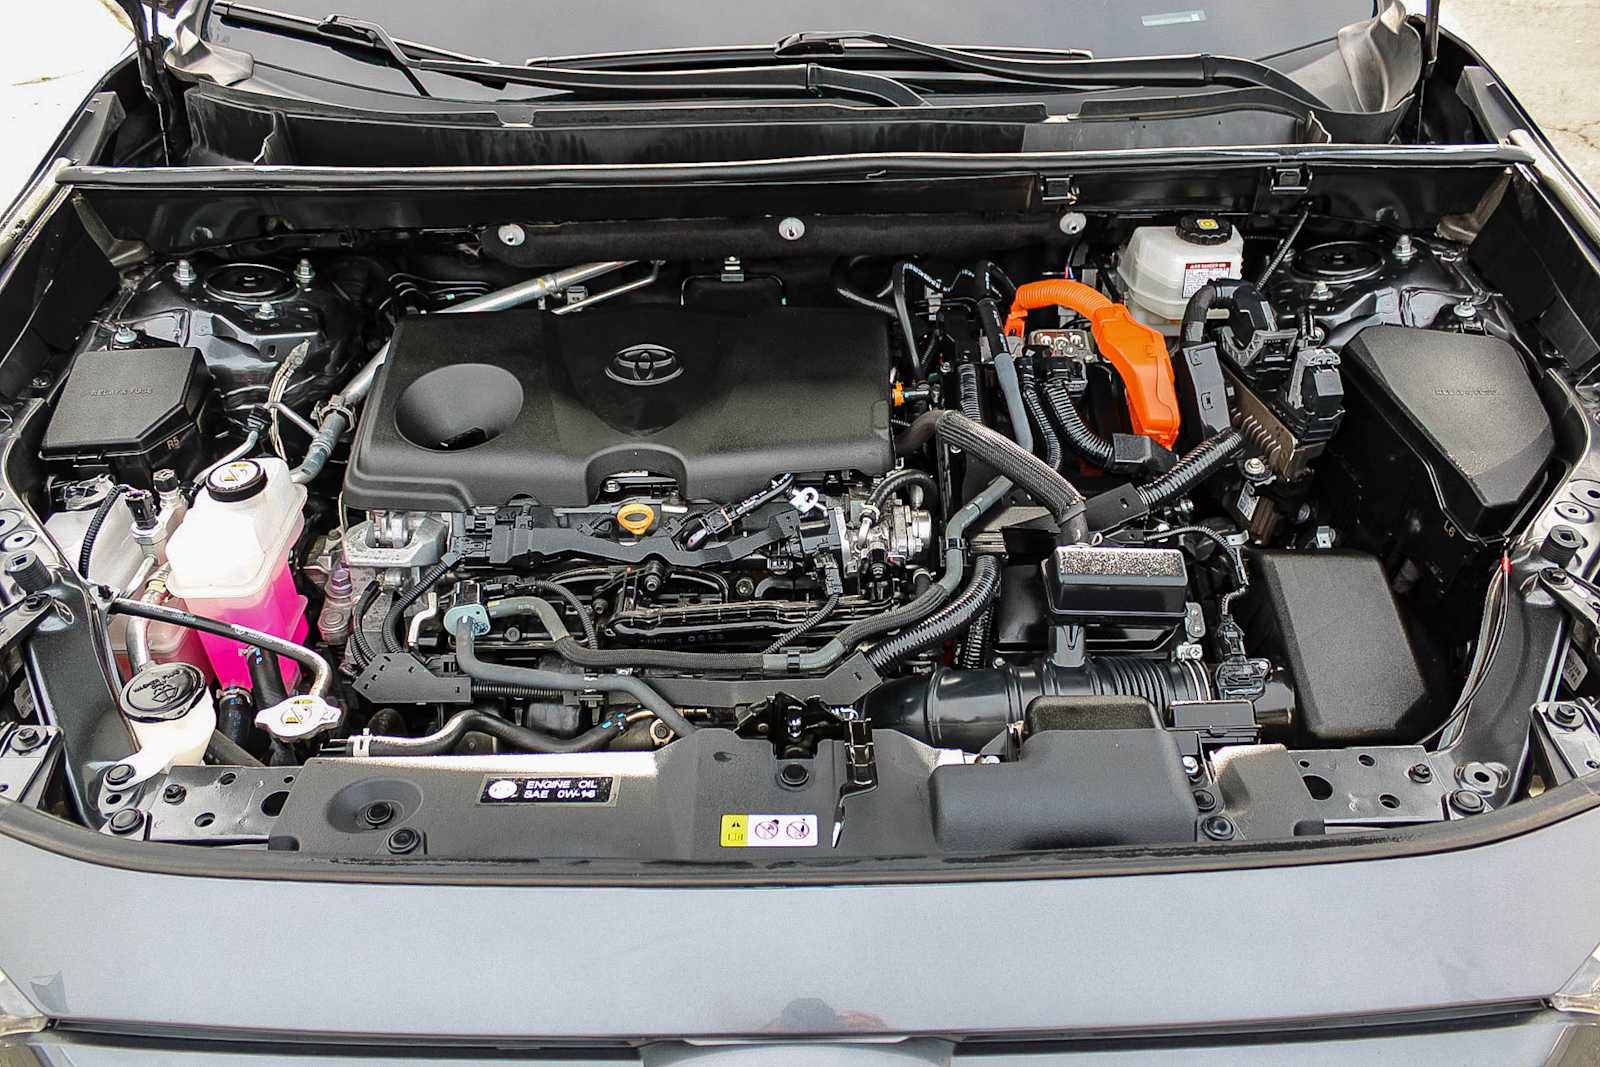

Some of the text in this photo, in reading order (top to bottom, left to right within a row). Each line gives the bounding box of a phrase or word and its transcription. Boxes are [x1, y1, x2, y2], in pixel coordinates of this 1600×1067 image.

[525, 780, 598, 790] ENGINE OIL
[523, 789, 550, 799] SAE
